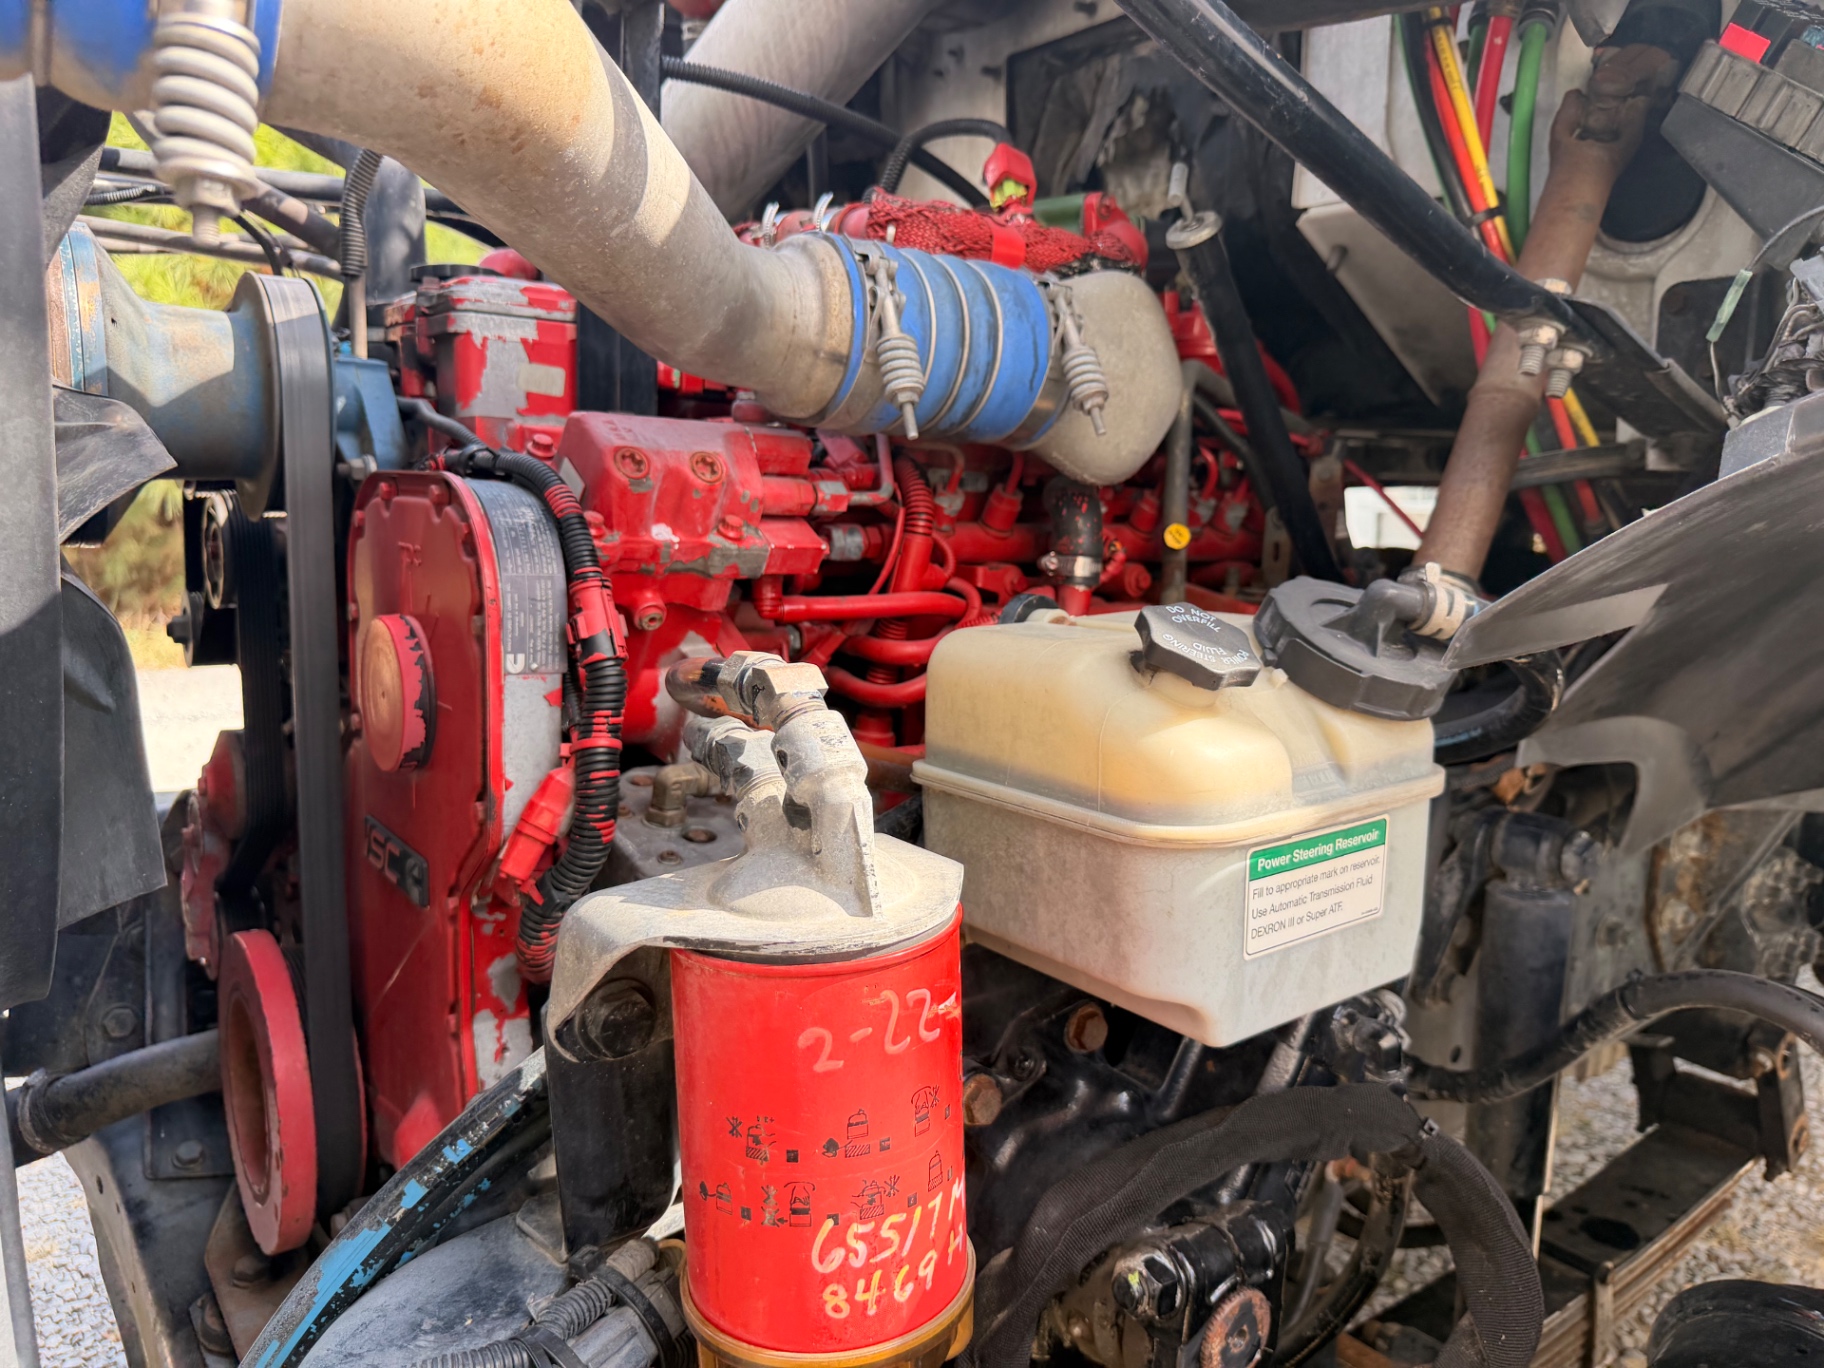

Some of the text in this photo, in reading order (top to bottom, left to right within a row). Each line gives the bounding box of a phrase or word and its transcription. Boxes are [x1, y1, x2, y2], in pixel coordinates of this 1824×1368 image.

[1166, 605, 1217, 621] DO NOT
[1172, 614, 1221, 633] OVERFILL
[1163, 633, 1250, 664] POWER STEERING
[1193, 642, 1227, 655] FLUID
[1257, 828, 1380, 872] Power Steering Reservoir
[1251, 874, 1374, 920] Use Automatic Transmission Fluid
[1252, 886, 1264, 900] Fill
[1265, 886, 1274, 896] to
[1275, 873, 1319, 895] appropriate
[1319, 866, 1338, 880] mark
[1339, 864, 1349, 875] on
[1250, 918, 1287, 940] DEXRON
[1296, 914, 1305, 925] or
[1305, 908, 1328, 922] Super
